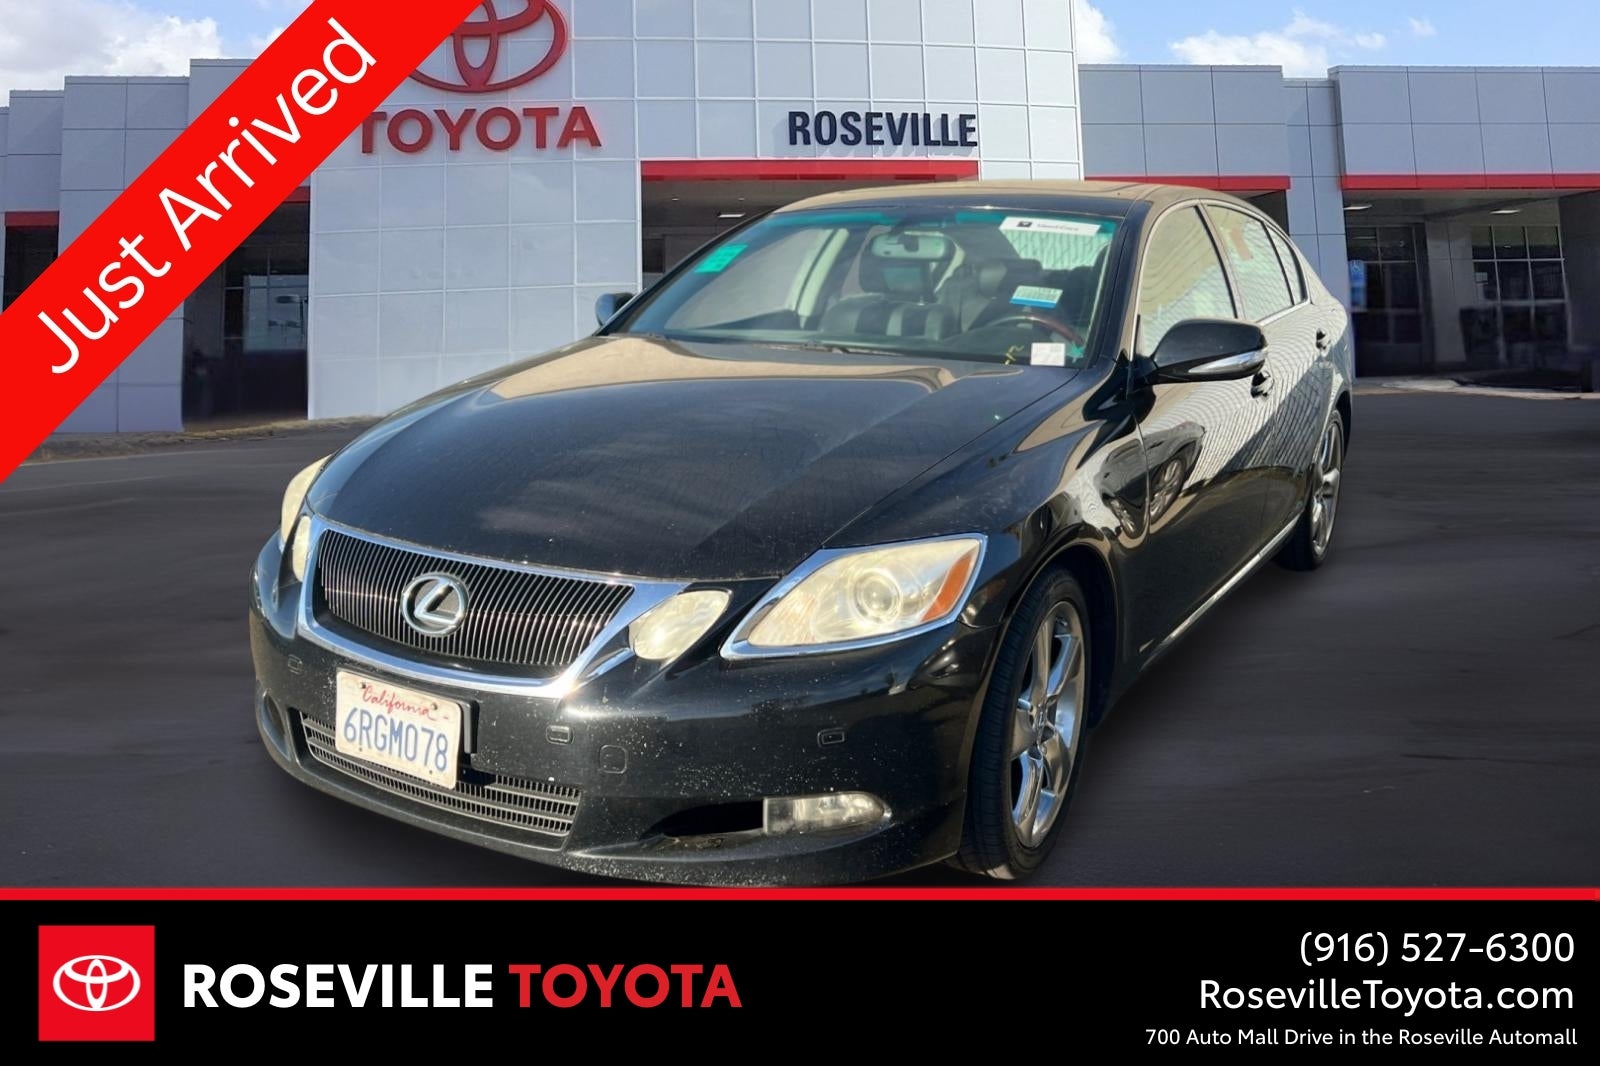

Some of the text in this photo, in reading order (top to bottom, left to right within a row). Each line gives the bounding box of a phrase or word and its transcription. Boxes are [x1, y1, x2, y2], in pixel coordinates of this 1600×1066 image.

[361, 106, 602, 154] TOYOTA
[788, 110, 978, 147] ROSEVILLE
[361, 684, 437, 722] California
[344, 707, 449, 773] 6RGM078
